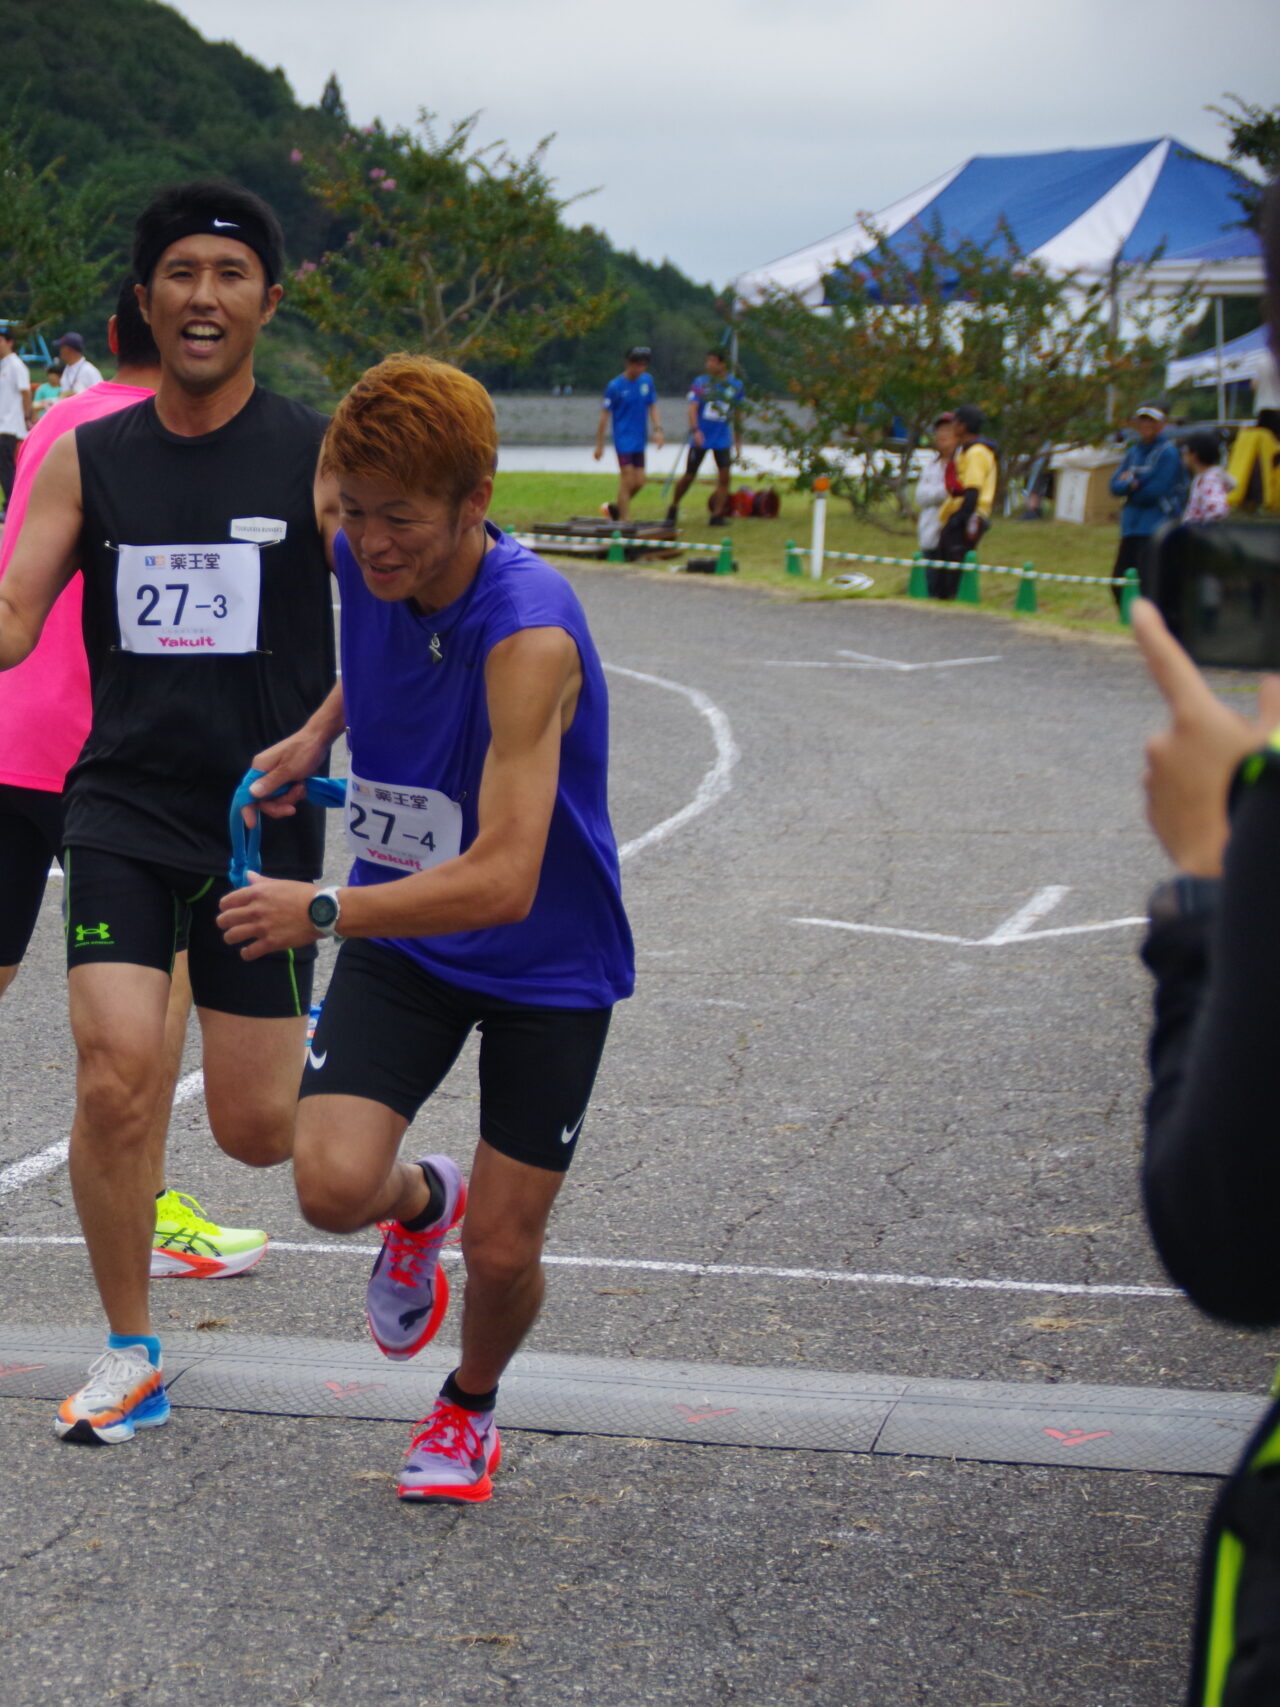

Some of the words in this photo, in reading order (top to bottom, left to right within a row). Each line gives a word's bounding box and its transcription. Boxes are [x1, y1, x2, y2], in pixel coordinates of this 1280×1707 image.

[170, 553, 220, 570] 薬王堂
[136, 583, 228, 626] 27-3
[157, 636, 216, 648] Yakult
[374, 787, 429, 810] 薬王堂
[366, 847, 424, 872] Yakult
